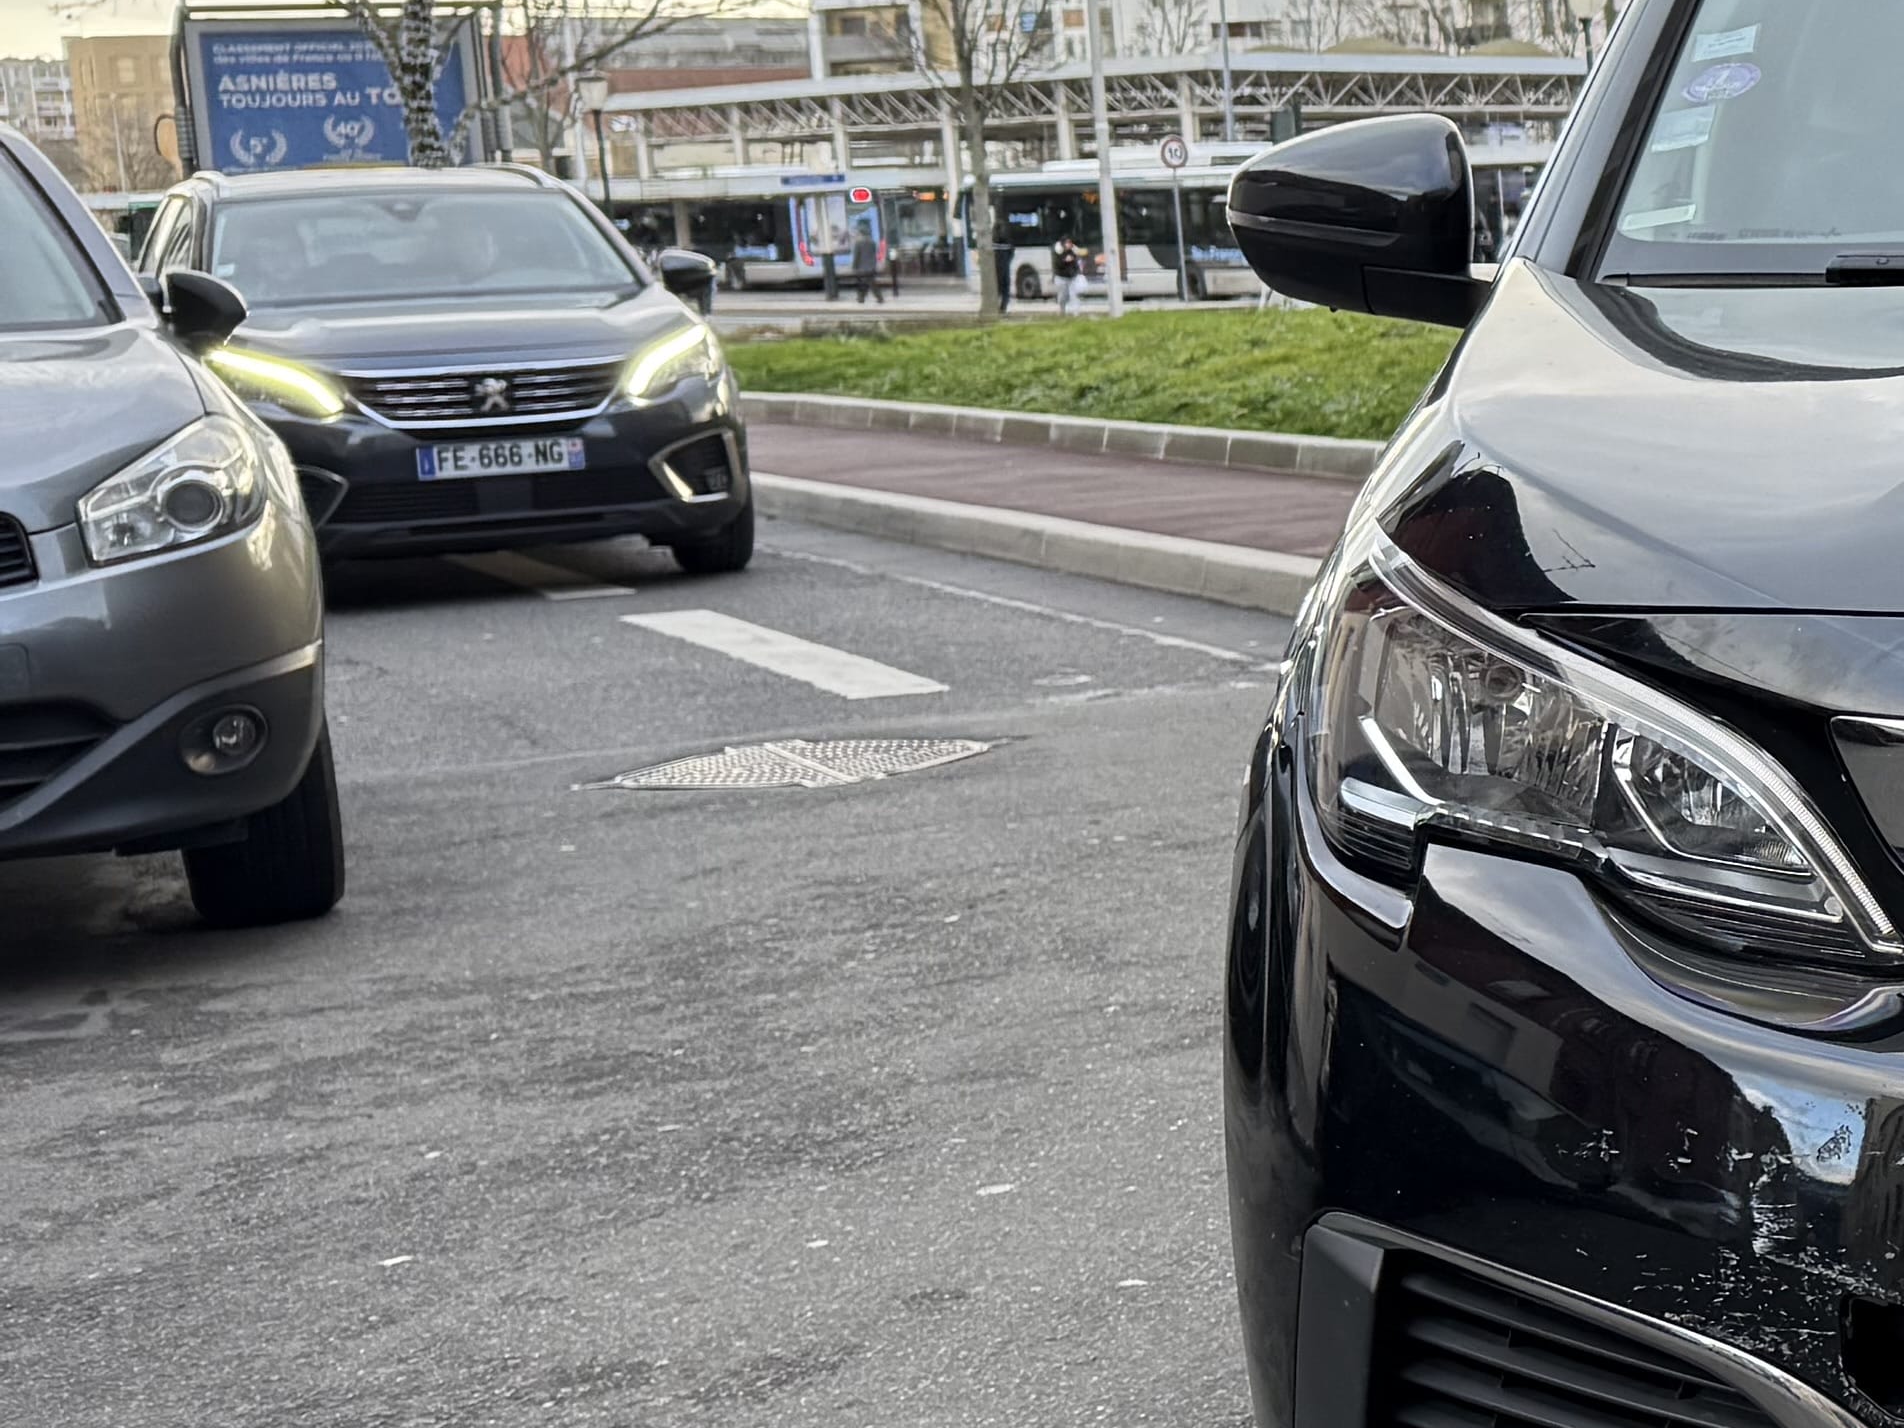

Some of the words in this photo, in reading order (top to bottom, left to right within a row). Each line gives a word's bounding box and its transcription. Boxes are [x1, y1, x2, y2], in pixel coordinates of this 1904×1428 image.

[219, 92, 327, 109] TOUJOURS
[333, 91, 361, 106] AU
[365, 87, 402, 106] TO
[436, 441, 564, 472] FE-666-NG
